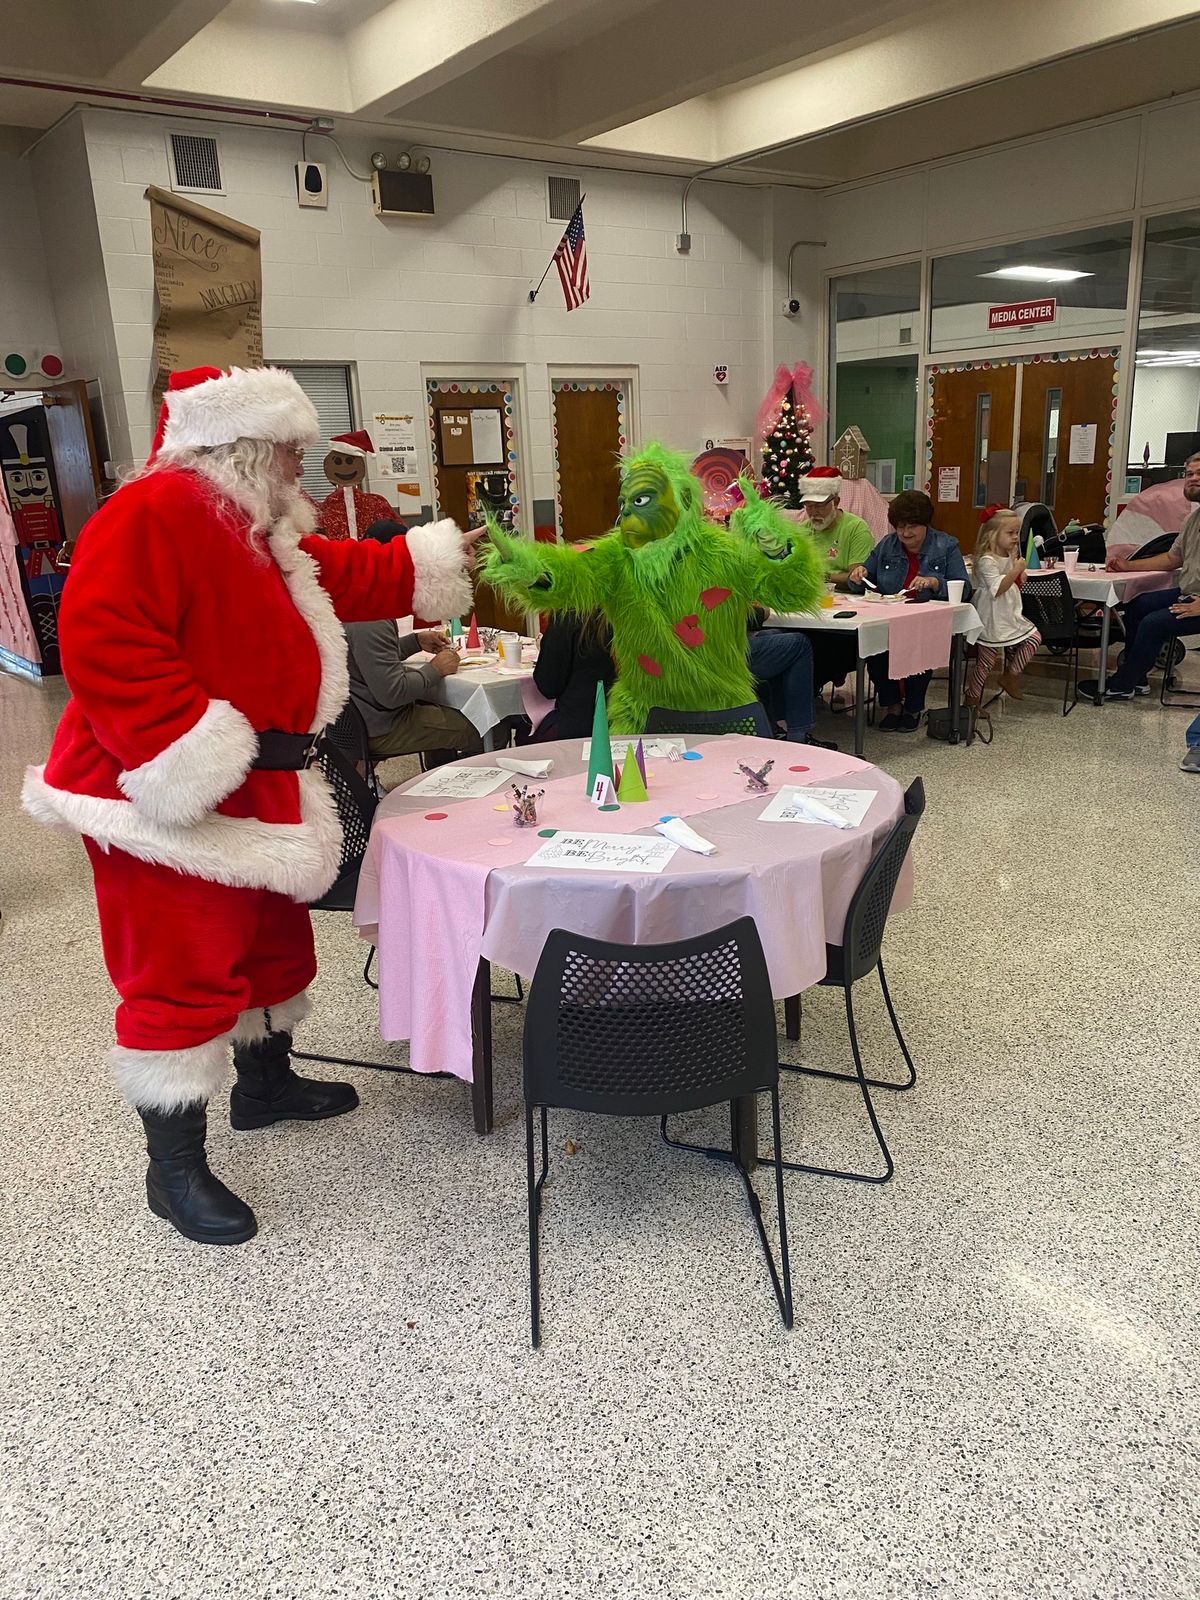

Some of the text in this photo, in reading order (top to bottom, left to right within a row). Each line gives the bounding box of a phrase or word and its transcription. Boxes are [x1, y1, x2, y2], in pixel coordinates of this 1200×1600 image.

[154, 209, 225, 260] Nice
[199, 280, 256, 309] NAUGHTY
[991, 305, 1052, 324] MEDIA CENTER
[456, 637, 462, 647] 1
[595, 781, 604, 801] 4
[563, 849, 589, 857] BE
